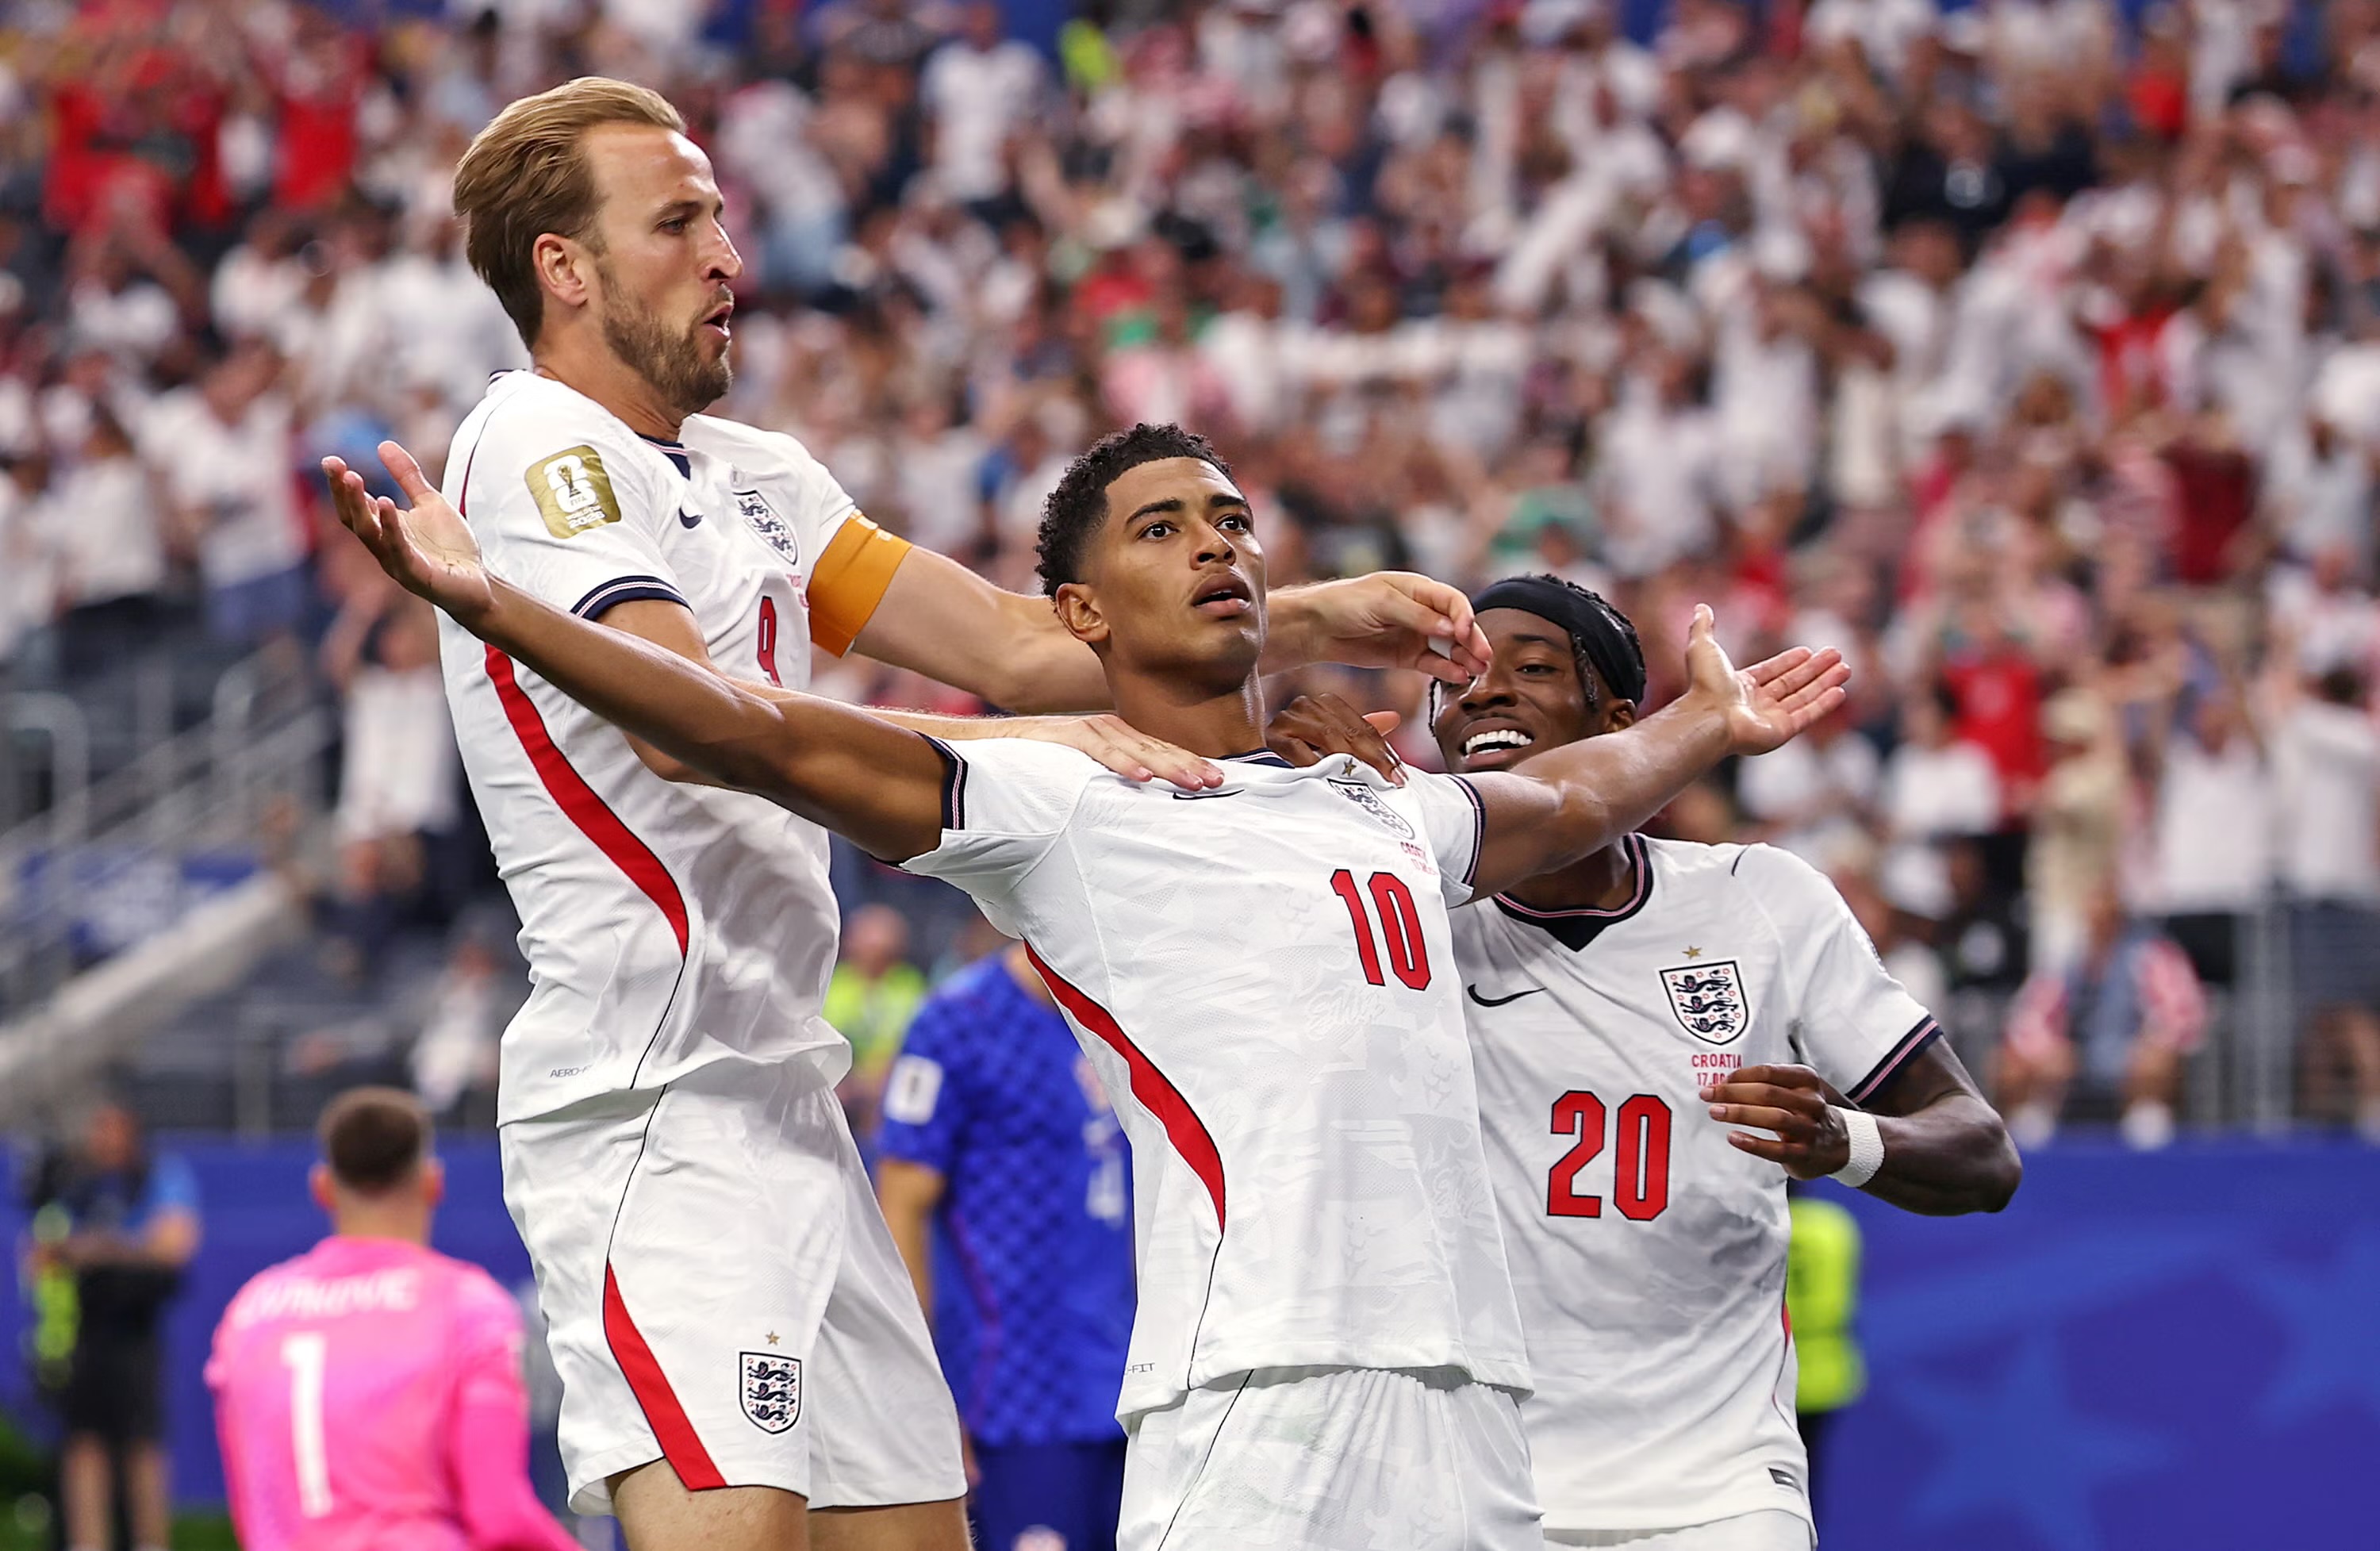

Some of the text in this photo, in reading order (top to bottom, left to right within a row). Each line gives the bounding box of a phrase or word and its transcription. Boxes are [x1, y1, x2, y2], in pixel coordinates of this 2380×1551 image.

[568, 510, 606, 530] 2026
[757, 595, 784, 688] 9
[1330, 869, 1431, 991] 10
[1691, 1054, 1742, 1068] CROATIA
[1547, 1090, 1672, 1221] 20
[279, 1334, 330, 1518] 1
